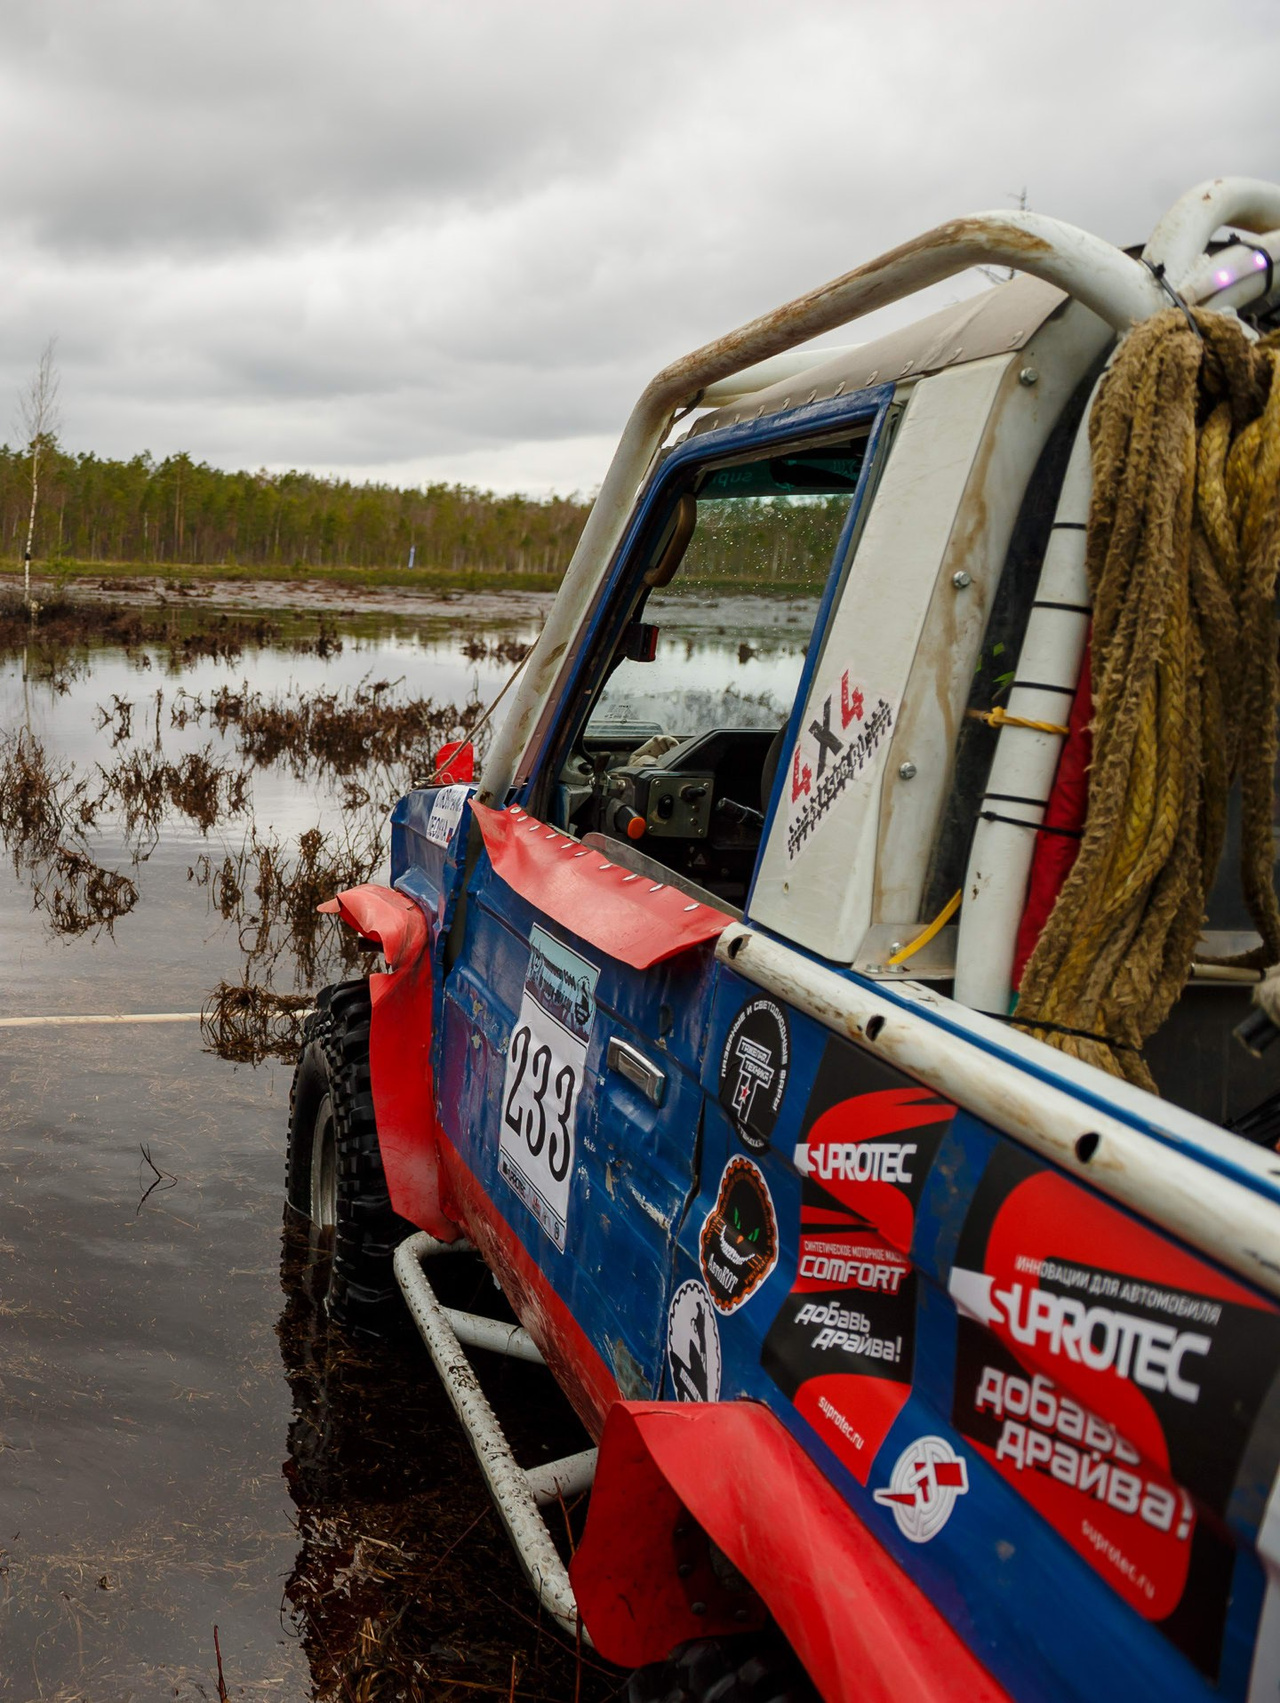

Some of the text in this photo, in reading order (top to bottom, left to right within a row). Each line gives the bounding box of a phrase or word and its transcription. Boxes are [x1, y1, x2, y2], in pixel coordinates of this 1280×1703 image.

[505, 1025, 575, 1182] 233
[794, 1143, 917, 1183] SUPROTEC
[800, 1255, 906, 1291] COMFORT
[1015, 1254, 1222, 1325] ИННОВАЦИИ ДЛЯ АВТОМОБИЛЯ
[948, 1266, 1211, 1404] SUPROTEC
[818, 1395, 865, 1451] suprotec.ru
